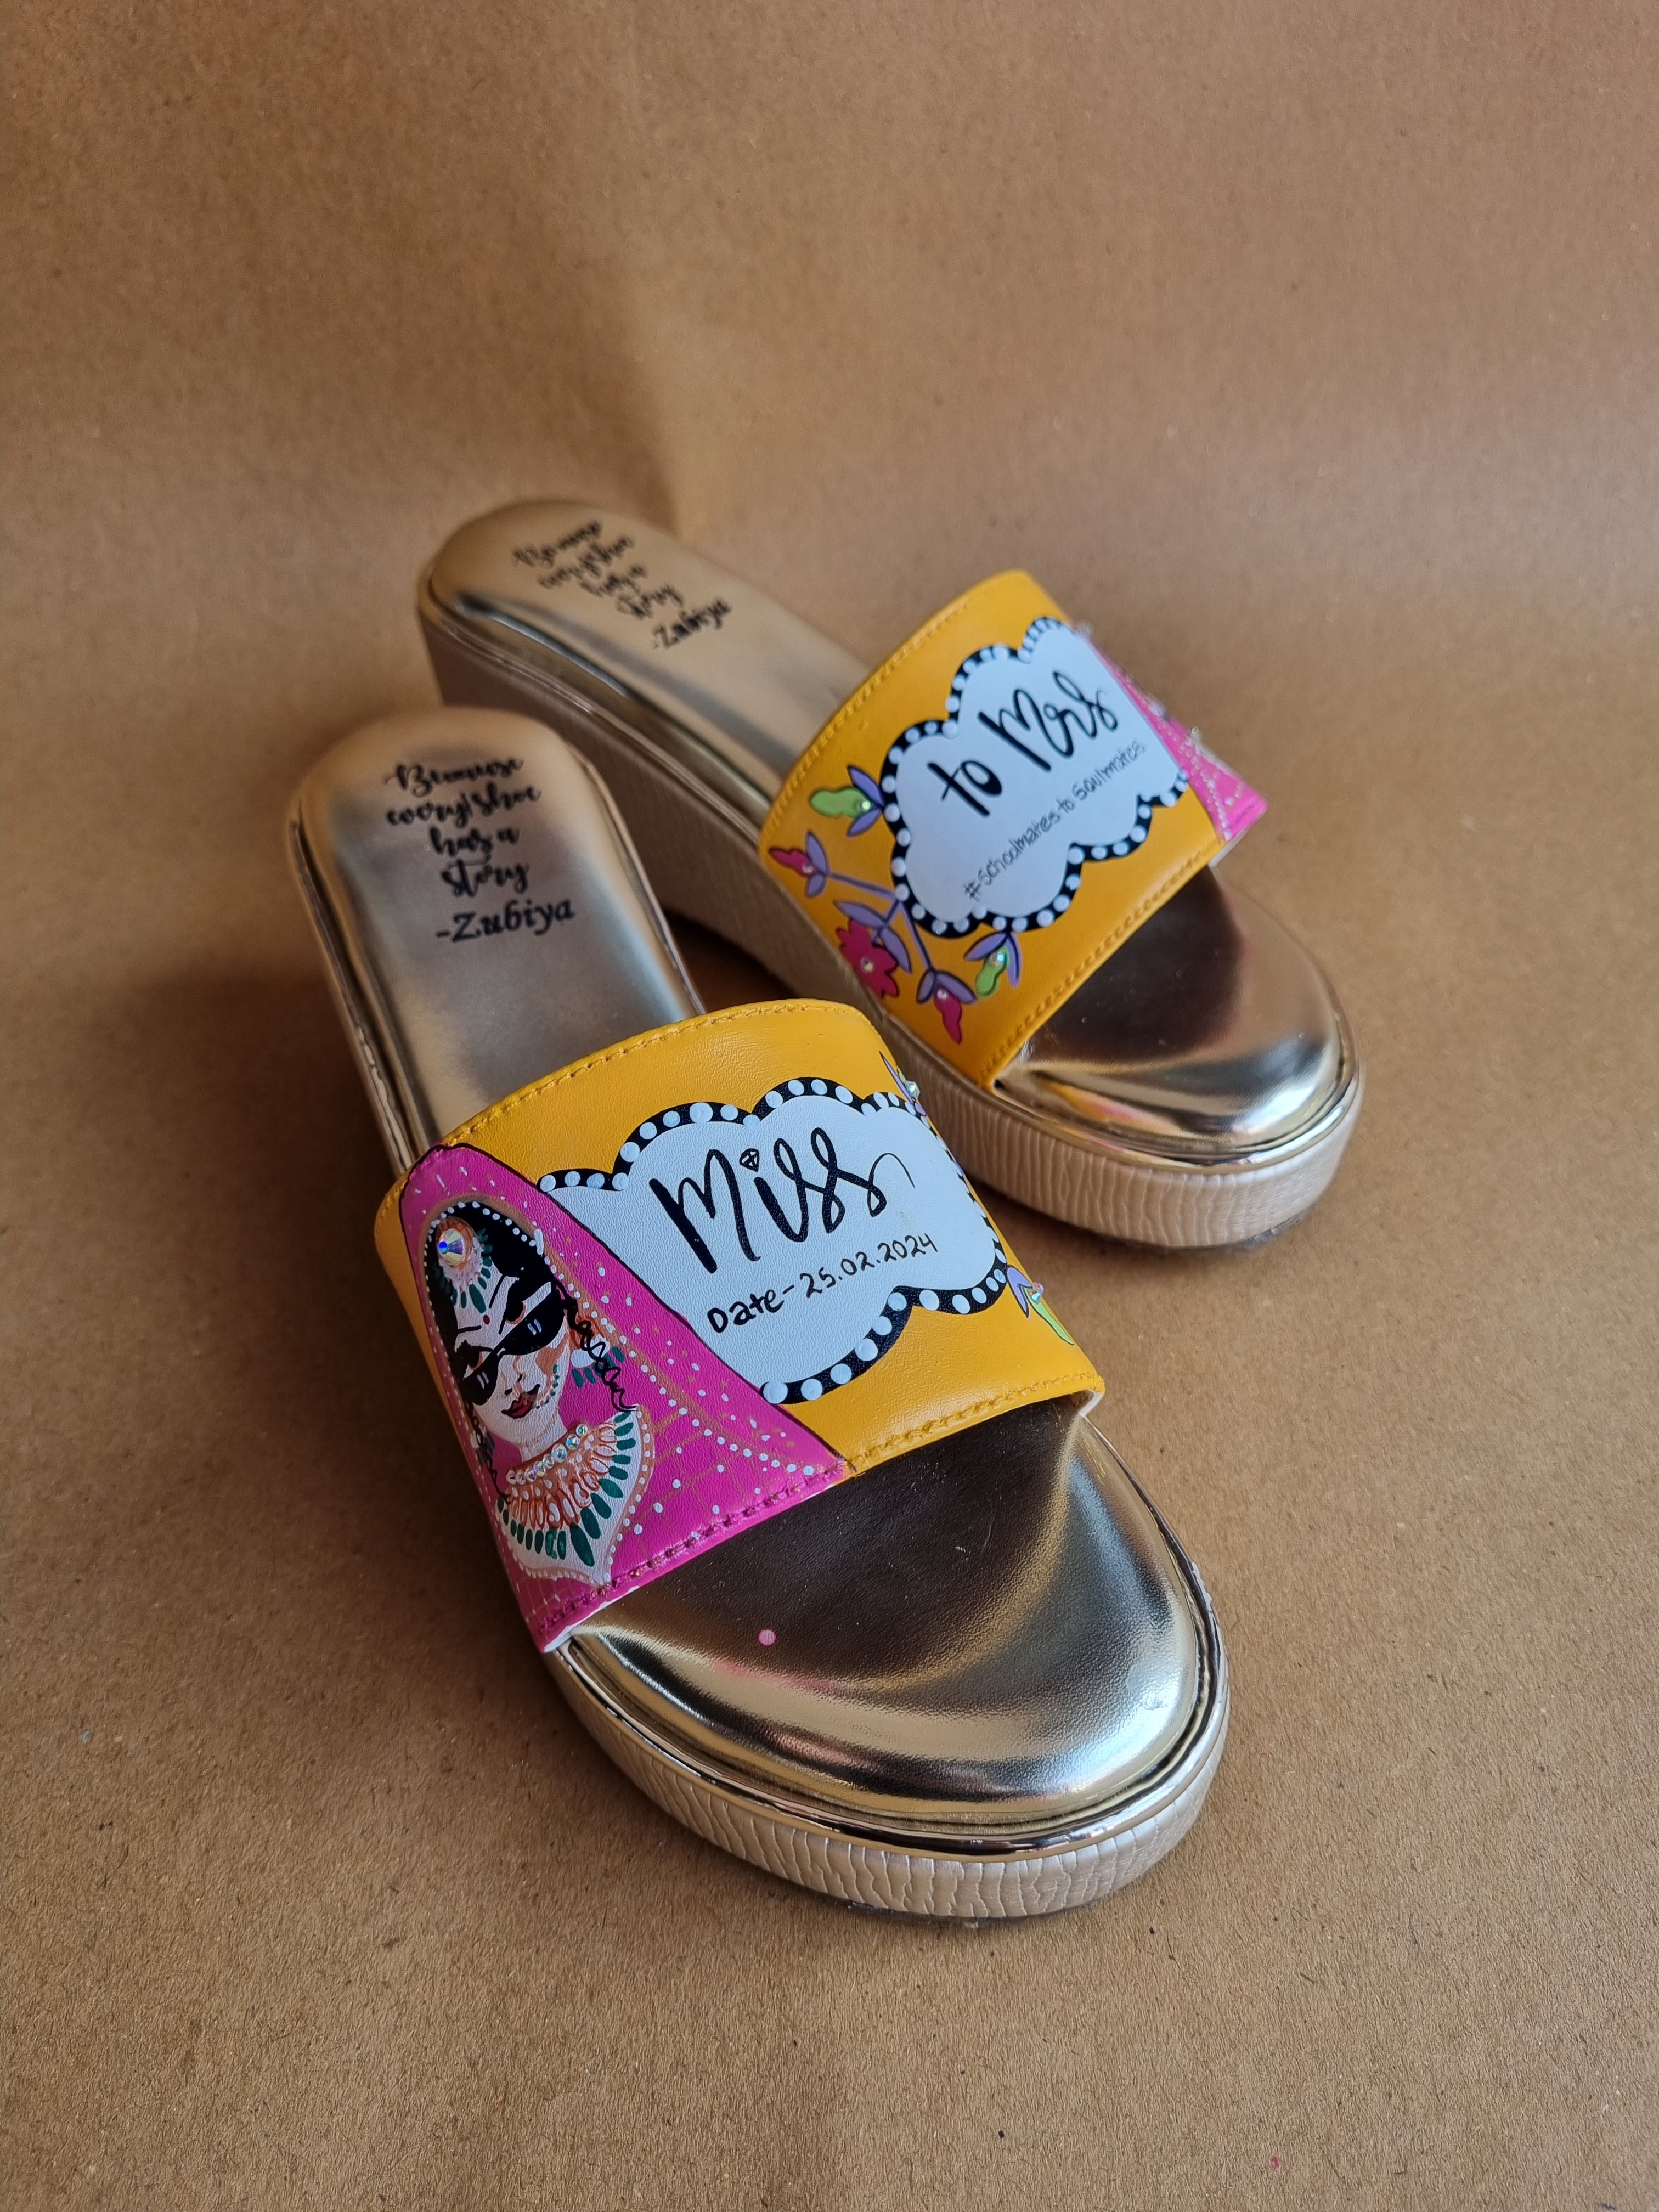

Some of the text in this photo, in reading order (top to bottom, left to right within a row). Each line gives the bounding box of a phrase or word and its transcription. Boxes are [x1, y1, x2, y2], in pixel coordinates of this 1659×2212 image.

[927, 670, 1119, 816] to Mrs
[1056, 799, 1075, 814] to
[649, 1127, 915, 1273] Miss
